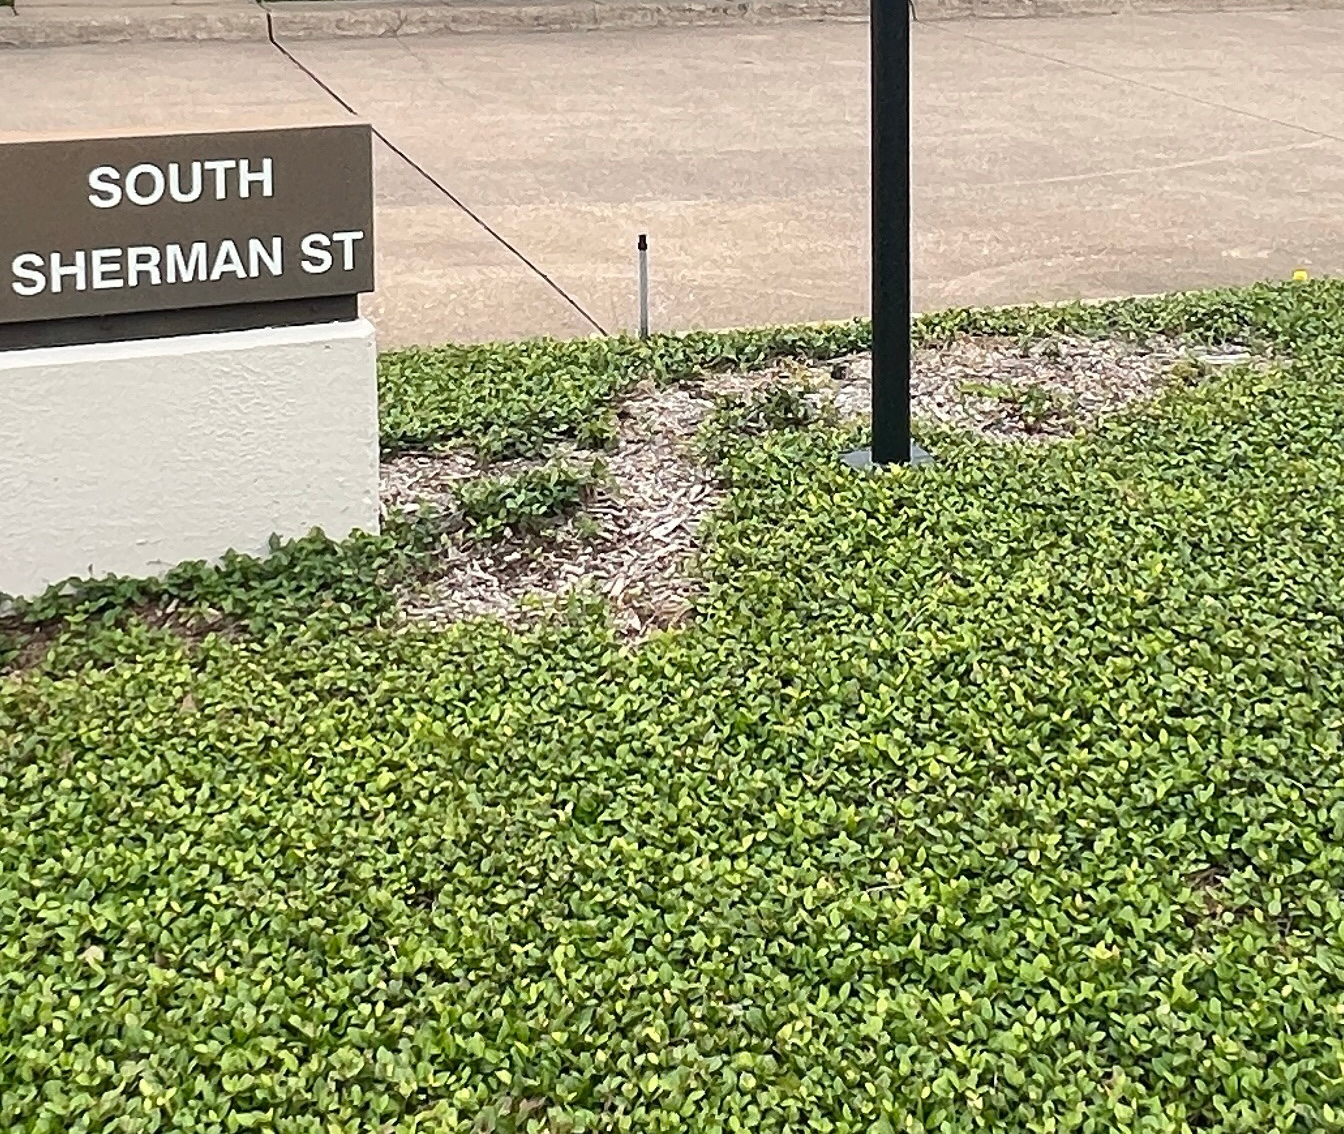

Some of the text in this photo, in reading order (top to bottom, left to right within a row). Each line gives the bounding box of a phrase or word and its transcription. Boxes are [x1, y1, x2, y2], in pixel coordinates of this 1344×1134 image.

[87, 157, 275, 209] SOUTH
[10, 229, 365, 297] SHERMAN ST
